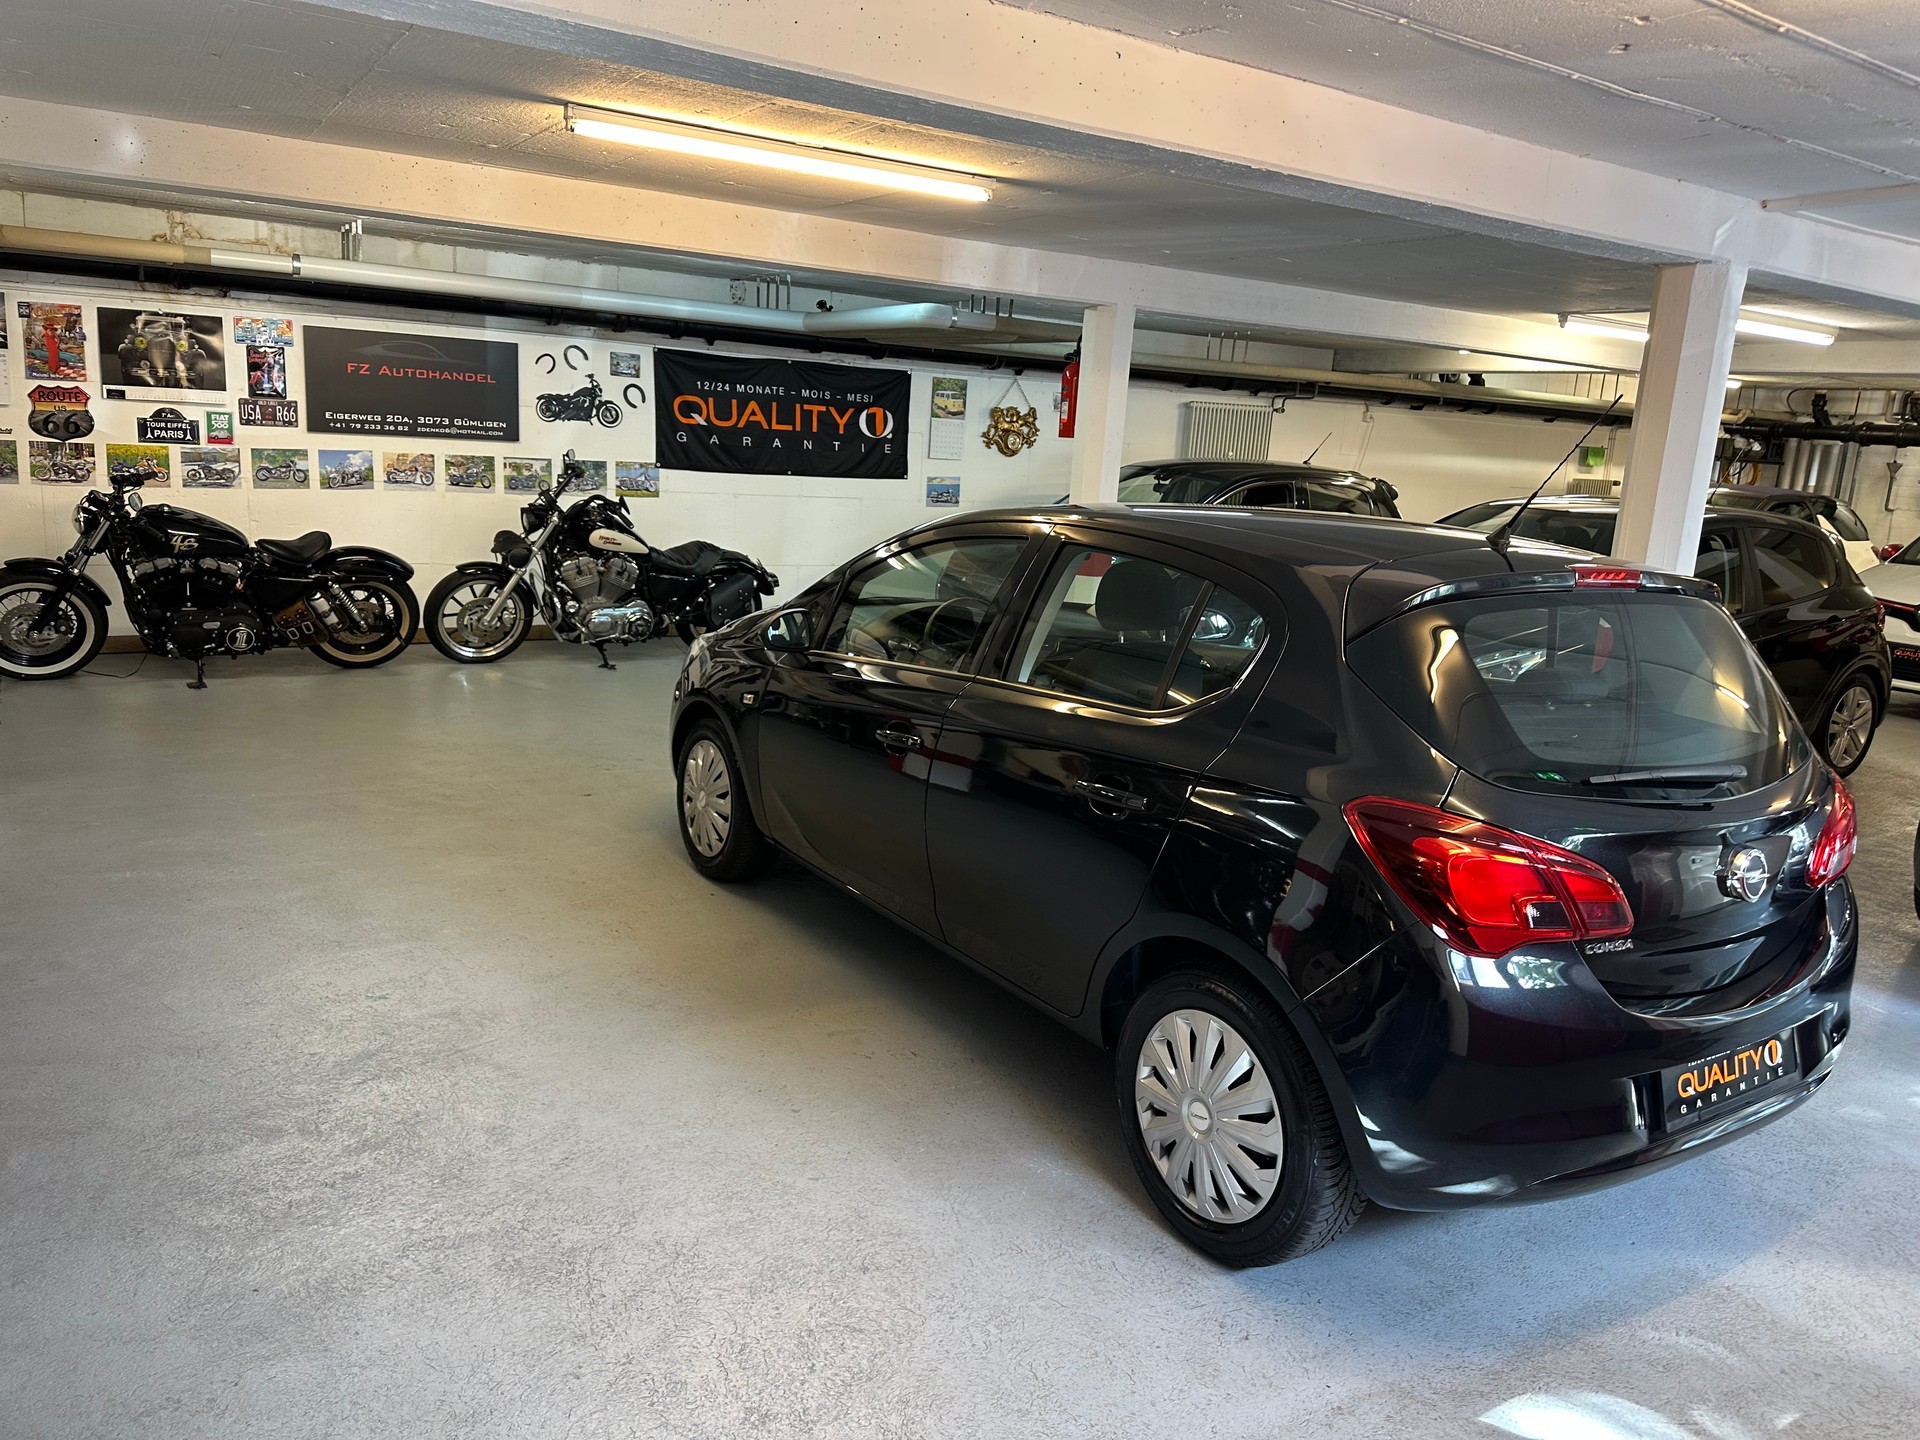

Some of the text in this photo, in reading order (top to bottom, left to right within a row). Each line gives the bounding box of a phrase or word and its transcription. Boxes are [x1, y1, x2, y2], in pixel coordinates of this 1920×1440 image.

[347, 362, 371, 375] FZ
[37, 390, 81, 402] ROUTE
[696, 380, 730, 392] 12/24
[736, 383, 785, 396] MONATE
[801, 389, 831, 400] MOIS
[847, 393, 873, 403] MESI
[241, 404, 296, 422] USA R66
[417, 416, 449, 425] 3073
[672, 394, 855, 435] QUALITY
[42, 412, 81, 435] 66
[211, 421, 229, 429] 500
[154, 429, 184, 439] PARIS
[676, 431, 892, 453] GARANTIE
[170, 534, 199, 554] 48
[1584, 938, 1634, 955] CORSA
[1677, 1045, 1763, 1098] QUALITY
[1680, 1066, 1784, 1114] GARANTIE
